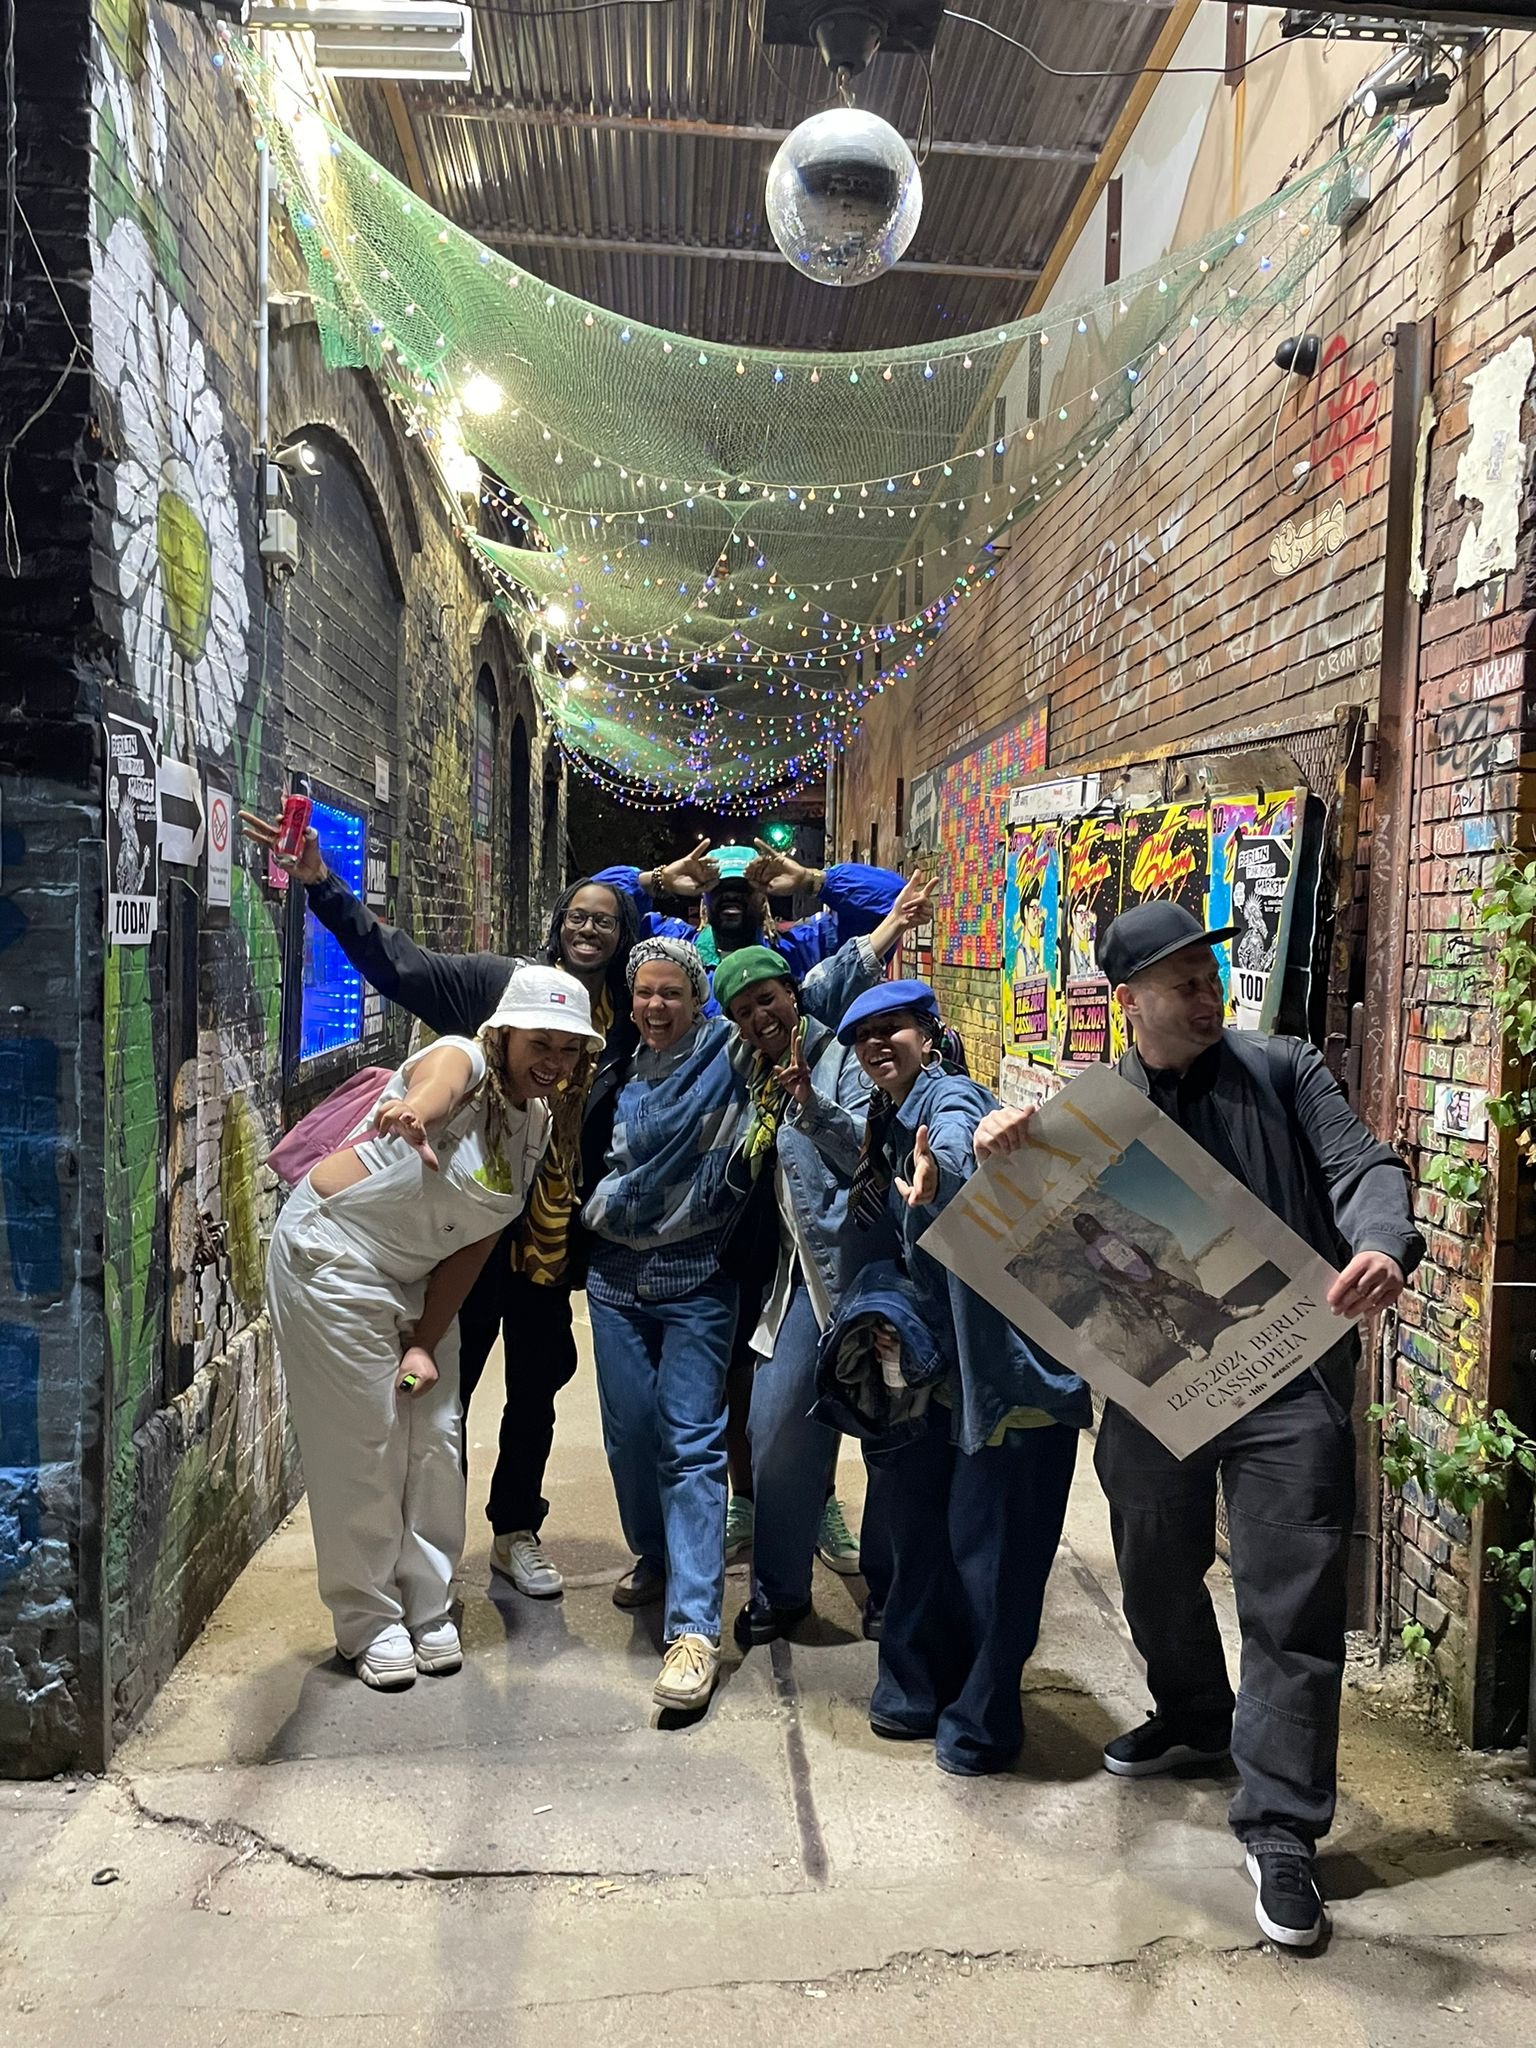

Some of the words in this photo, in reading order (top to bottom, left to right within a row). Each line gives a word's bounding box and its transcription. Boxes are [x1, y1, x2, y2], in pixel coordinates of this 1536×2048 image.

[1239, 846, 1269, 867] BERLIN
[1257, 879, 1286, 896] MARKET
[115, 899, 151, 935] TODAY
[1239, 972, 1268, 1002] TOD
[1166, 1350, 1248, 1412] 12.05.2024
[1248, 1295, 1318, 1351] BERLIN
[1205, 1332, 1308, 1409] CASSIOPEIA
